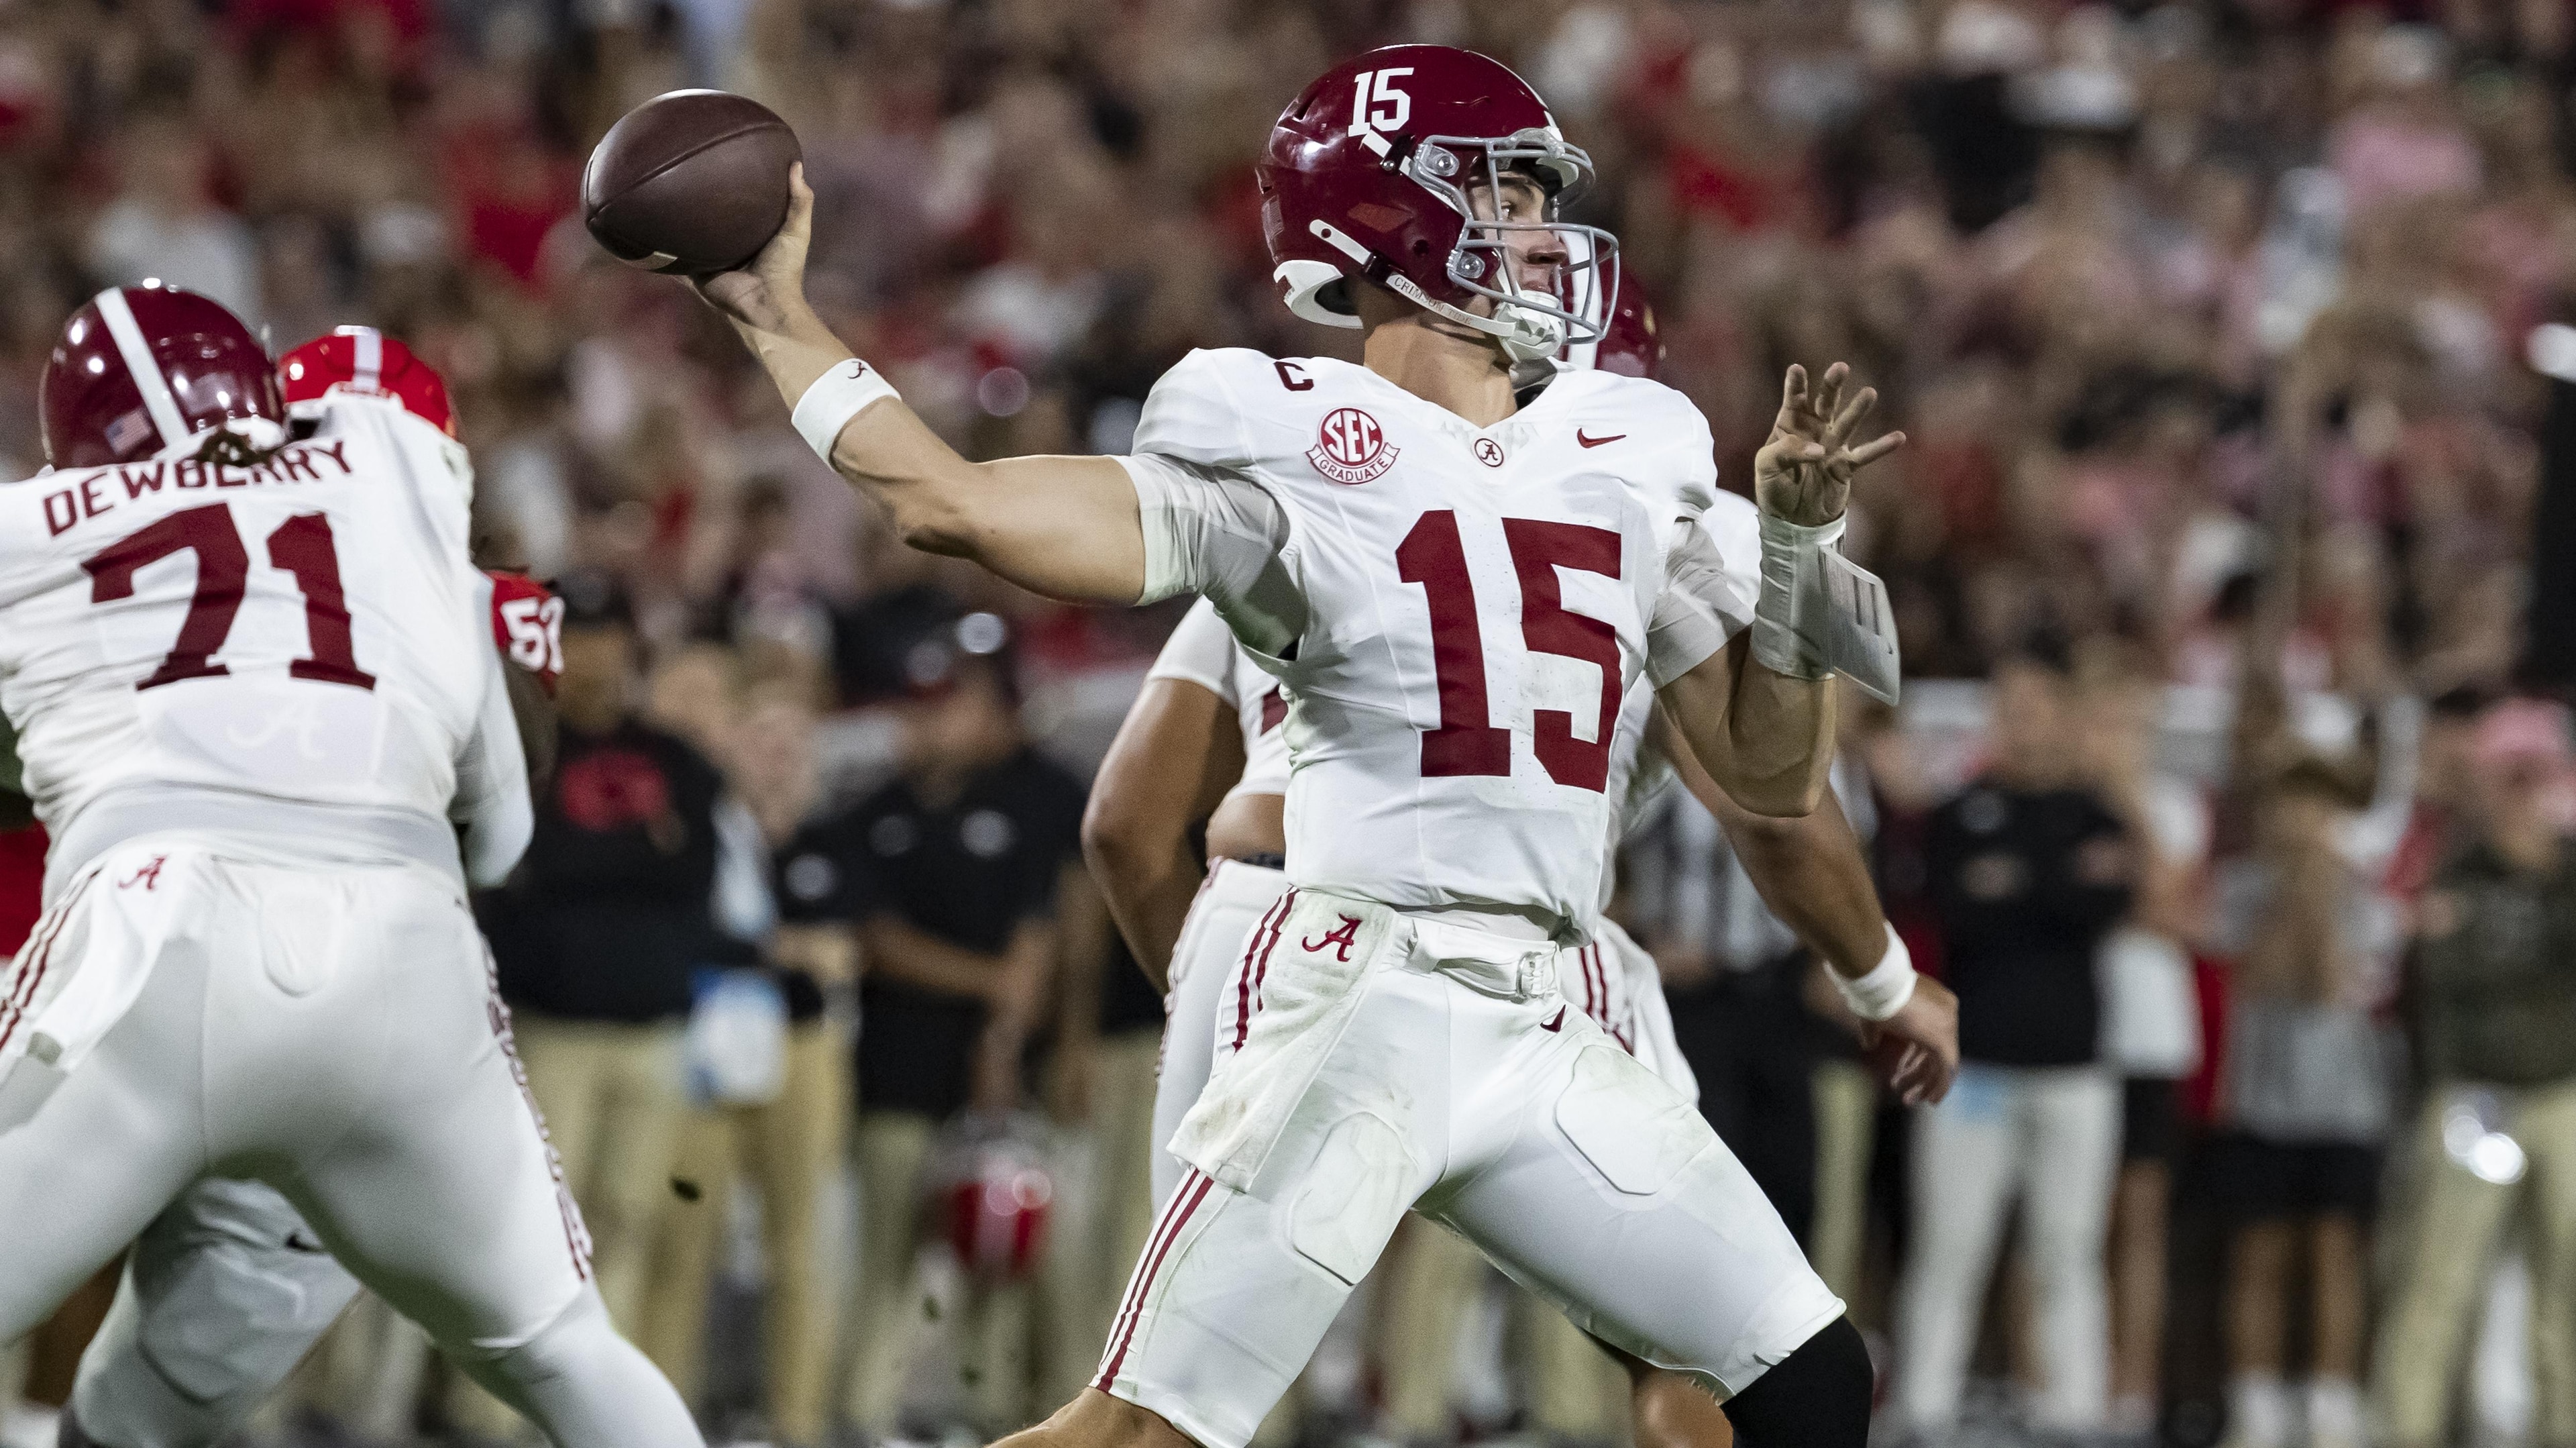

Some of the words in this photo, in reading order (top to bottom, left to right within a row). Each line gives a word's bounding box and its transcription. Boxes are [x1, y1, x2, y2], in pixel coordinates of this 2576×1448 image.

[1348, 67, 1414, 137] 15
[1274, 361, 1314, 391] C
[1324, 410, 1379, 463] SEC
[1320, 458, 1389, 482] GRADUATE
[80, 503, 376, 690] 71
[1397, 510, 1622, 792] 15
[1301, 912, 1363, 962] A
